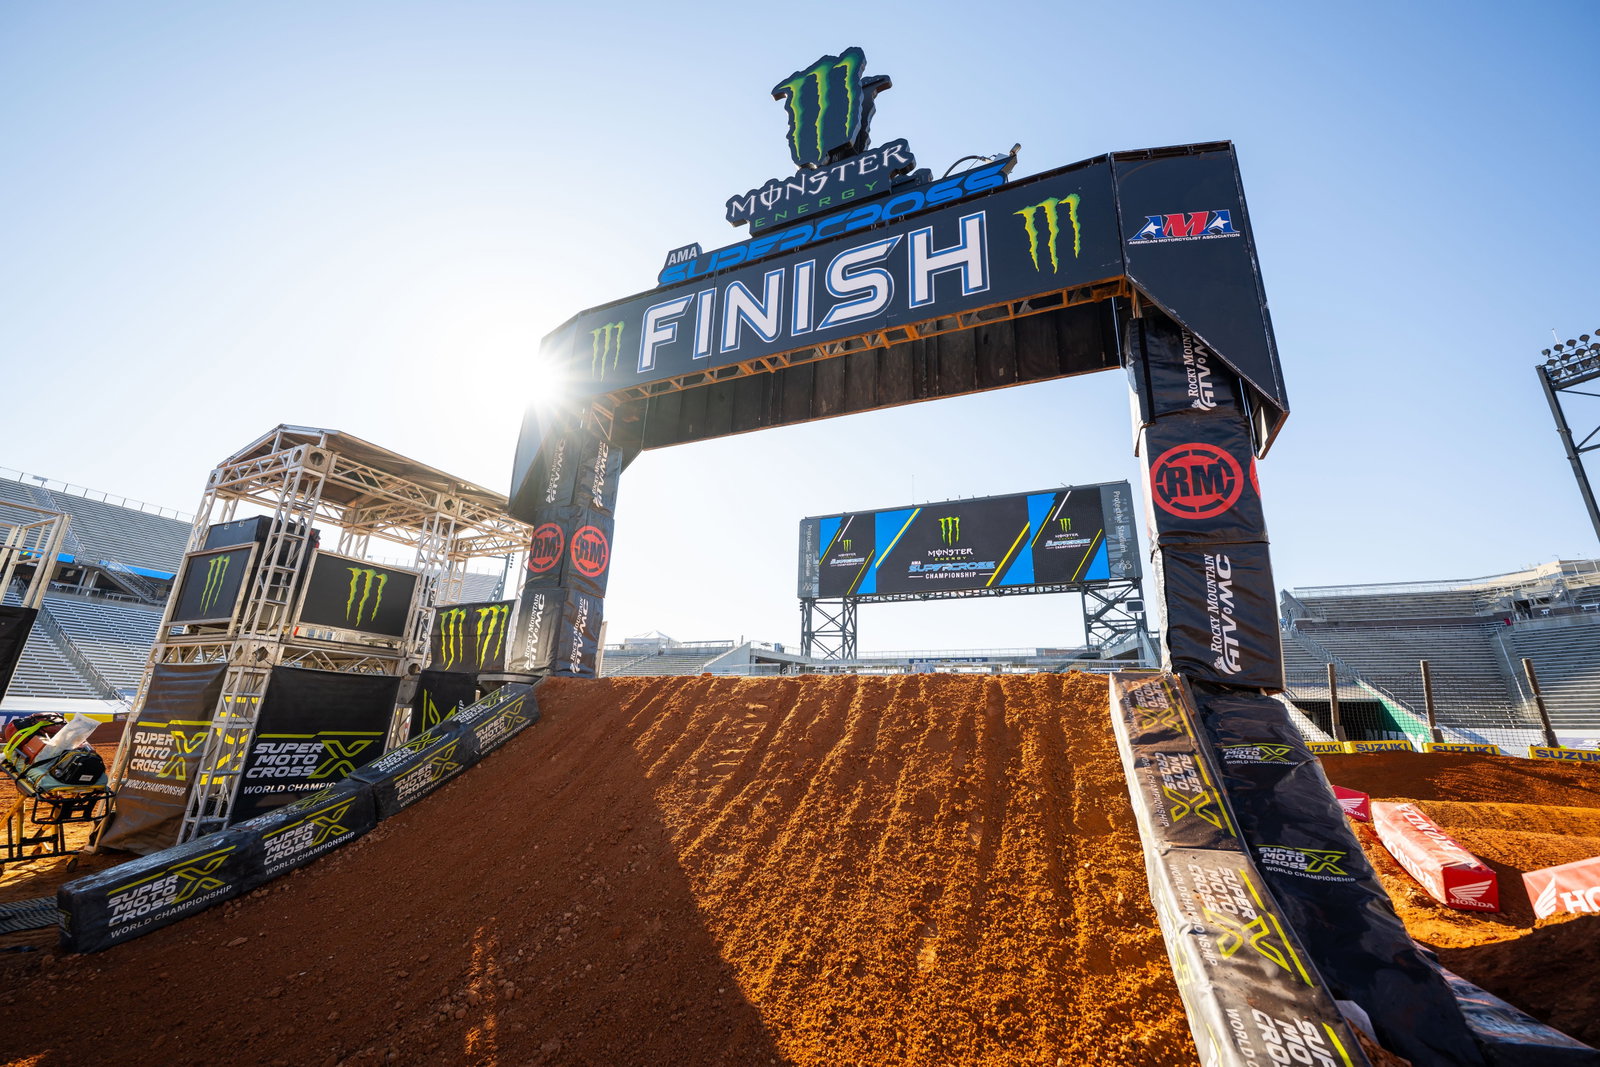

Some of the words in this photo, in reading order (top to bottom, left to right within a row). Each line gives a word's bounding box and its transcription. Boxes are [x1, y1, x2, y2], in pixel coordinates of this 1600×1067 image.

[730, 143, 909, 219] MONSTER
[755, 180, 878, 227] ENERGY
[659, 162, 1007, 285] SUPERCROSS
[1127, 209, 1240, 241] AMA
[1202, 232, 1240, 240] ASSOCIATION
[667, 246, 698, 266] AMA
[636, 210, 990, 374] FINISH
[1187, 367, 1199, 397] ROCKY
[1166, 463, 1226, 498] RM
[1113, 490, 1122, 524] Protective
[1118, 524, 1127, 553] Stadium
[532, 536, 558, 560] RM
[928, 547, 973, 557] MONSTER
[908, 560, 995, 573] SUPERCROSS
[925, 571, 976, 579] CHAMPIONSHIP
[1204, 554, 1218, 614] MOUNTAIN
[528, 594, 540, 633] MOUNTAIN
[573, 597, 584, 637] MOUNTAIN
[524, 633, 533, 658] ROCKY
[570, 637, 578, 661] ROCKY
[1210, 616, 1222, 655] ROCKY
[1151, 681, 1170, 710] SUPER
[133, 731, 175, 746] SUPER
[476, 716, 505, 738] SUPER
[480, 722, 505, 743] MOTO
[134, 745, 171, 760] MOTO
[253, 742, 324, 754] SUPER
[254, 754, 318, 766] MOTO
[1307, 744, 1342, 753] UZUKI
[1355, 743, 1409, 752] SUZUKI
[1535, 749, 1600, 762] SUZUK
[130, 758, 166, 773] CROSS
[246, 765, 317, 779] CROSS
[394, 763, 433, 789] SUPER
[1154, 752, 1177, 790] CROSS
[1167, 754, 1190, 790] MOTO
[1178, 752, 1203, 793] SUPER
[125, 778, 144, 789] WORLD
[144, 780, 186, 796] CHAMPIONSHIP
[243, 784, 285, 794] WORLD
[287, 782, 336, 792] CHAMPIO
[397, 775, 433, 800] CROSS
[399, 770, 432, 794] MOTO
[400, 791, 422, 807] WORLD
[1147, 775, 1169, 827] CHAMPIONSHIP
[1343, 808, 1367, 819] ONDA
[264, 822, 315, 850] SUPER
[266, 830, 313, 856] MOTO
[263, 838, 315, 866] CROSS
[266, 858, 296, 875] WORLD
[297, 831, 355, 861] CHAMPIONSHIP
[1258, 847, 1305, 857] SUPER
[1261, 858, 1308, 870] CROSS
[1263, 852, 1306, 863] MOTO
[1169, 864, 1188, 892] WORLD
[1265, 866, 1293, 875] WORLD
[1294, 871, 1356, 882] CHAMPIONSHIP
[107, 874, 178, 909] SUPER
[113, 885, 177, 916] MOTO
[1188, 864, 1223, 913] CROSS
[1203, 867, 1239, 915] MOTO
[1217, 866, 1258, 920] SUPER
[108, 893, 178, 927] CROSS
[111, 918, 152, 938] WORLD
[154, 884, 233, 921] CHAMPIONSHIP
[1450, 899, 1496, 909] HONDA
[1225, 1008, 1256, 1059] WORLD
[1251, 1008, 1292, 1067] CRO
[1274, 1018, 1314, 1067] MO
[1293, 1017, 1337, 1067] SUP
